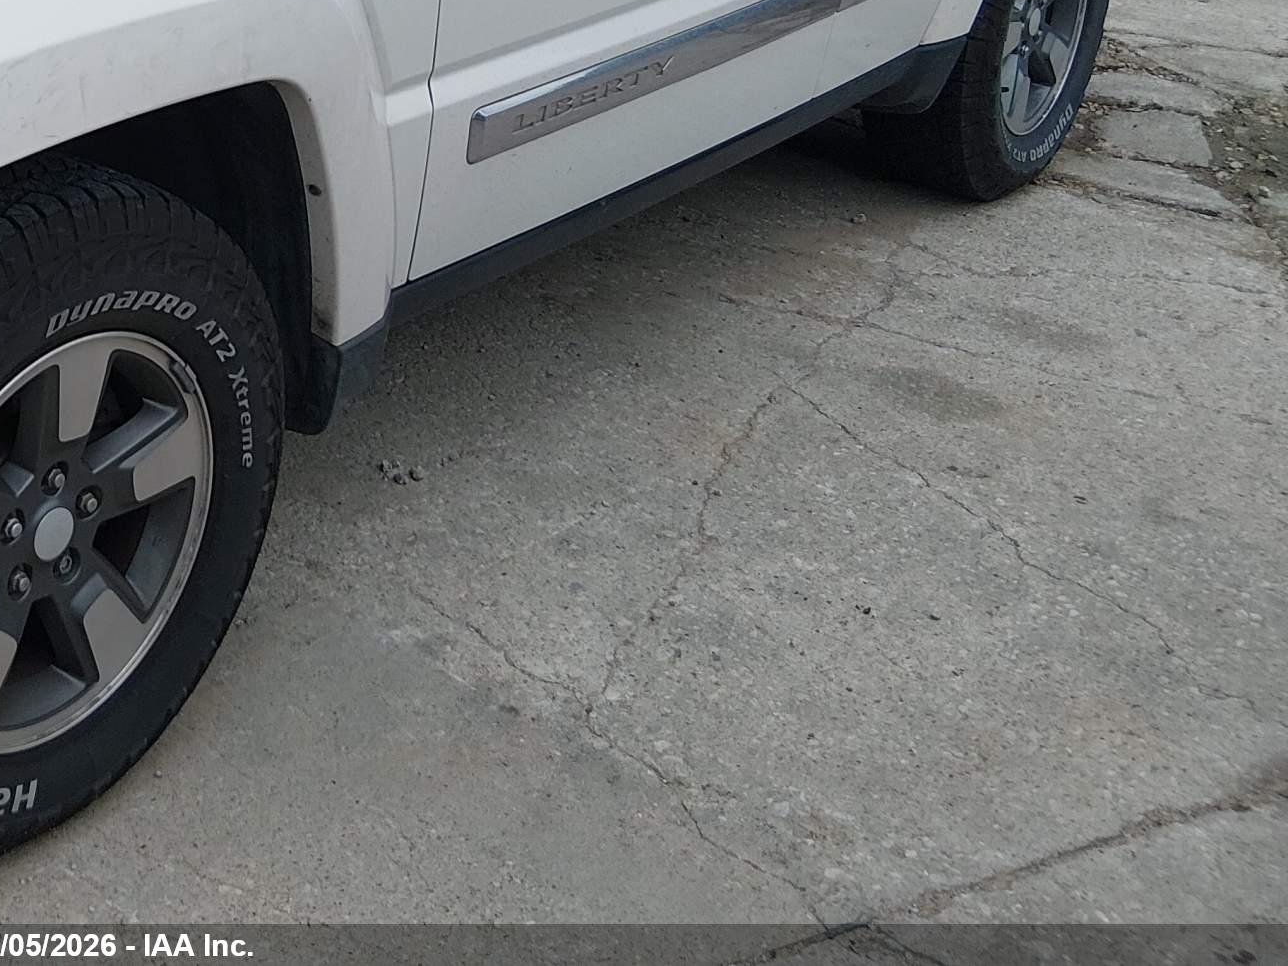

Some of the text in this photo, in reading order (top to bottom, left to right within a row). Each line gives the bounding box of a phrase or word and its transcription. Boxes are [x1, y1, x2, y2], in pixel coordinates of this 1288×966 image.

[514, 56, 675, 131] LIBERTY
[195, 319, 237, 363] AT2
[228, 364, 255, 469] Xtreme
